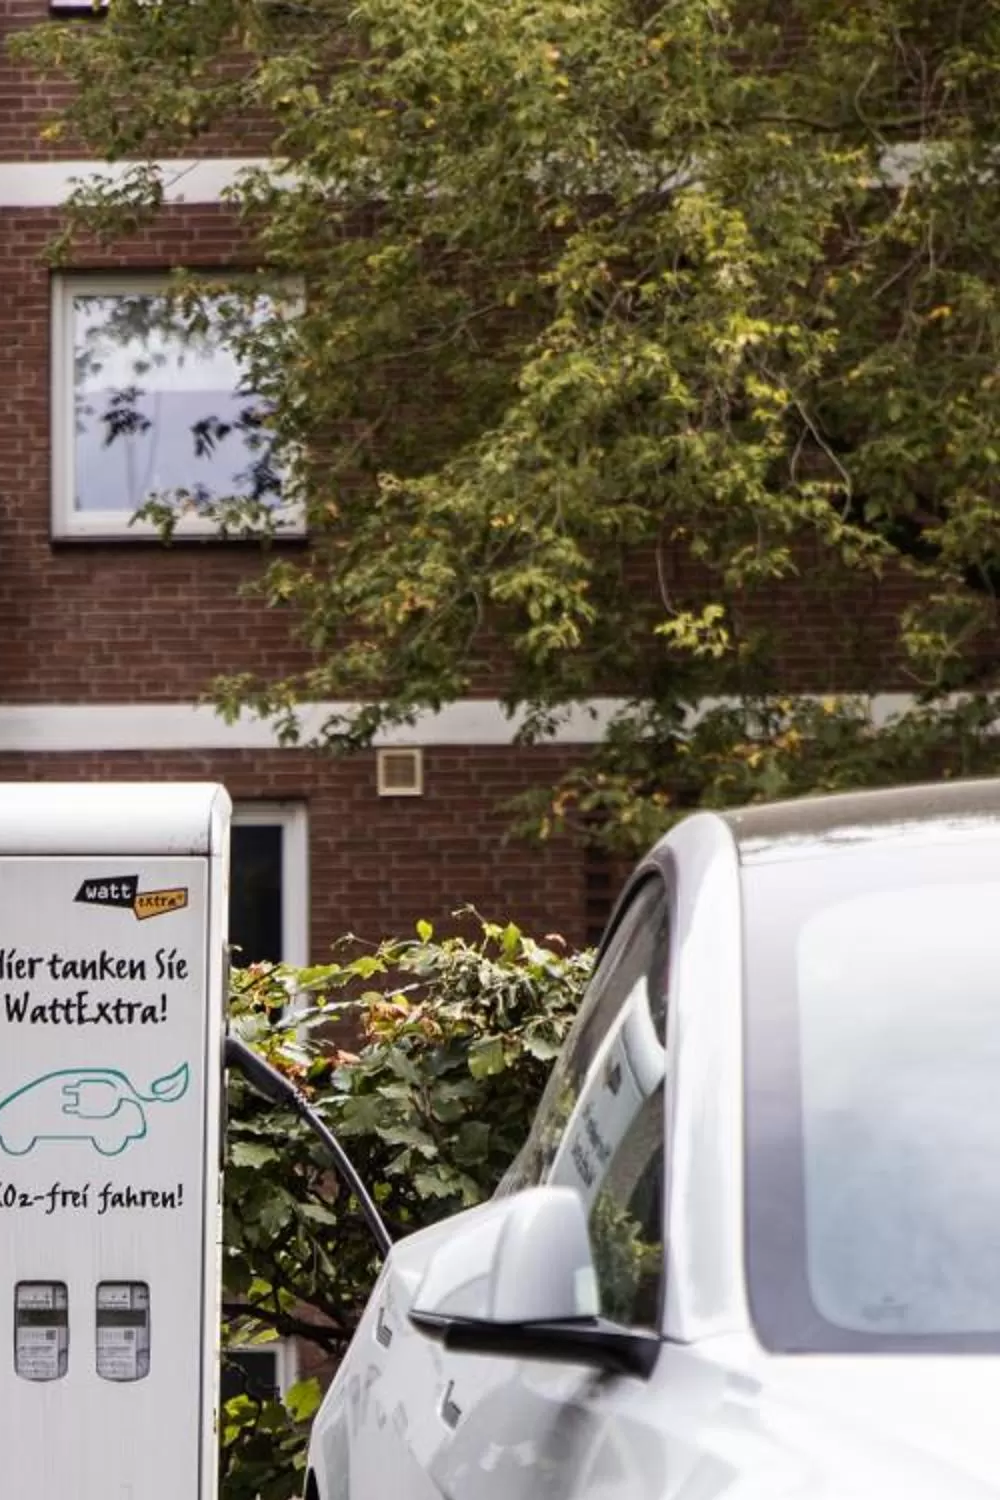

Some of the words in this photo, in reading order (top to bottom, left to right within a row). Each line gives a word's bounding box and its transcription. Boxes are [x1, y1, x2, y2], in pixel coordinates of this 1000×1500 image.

[85, 883, 132, 900] watt
[48, 949, 147, 982] tanken
[155, 947, 189, 981] Sie
[4, 989, 168, 1026] WattExtra!
[97, 1181, 184, 1216] fahren!
